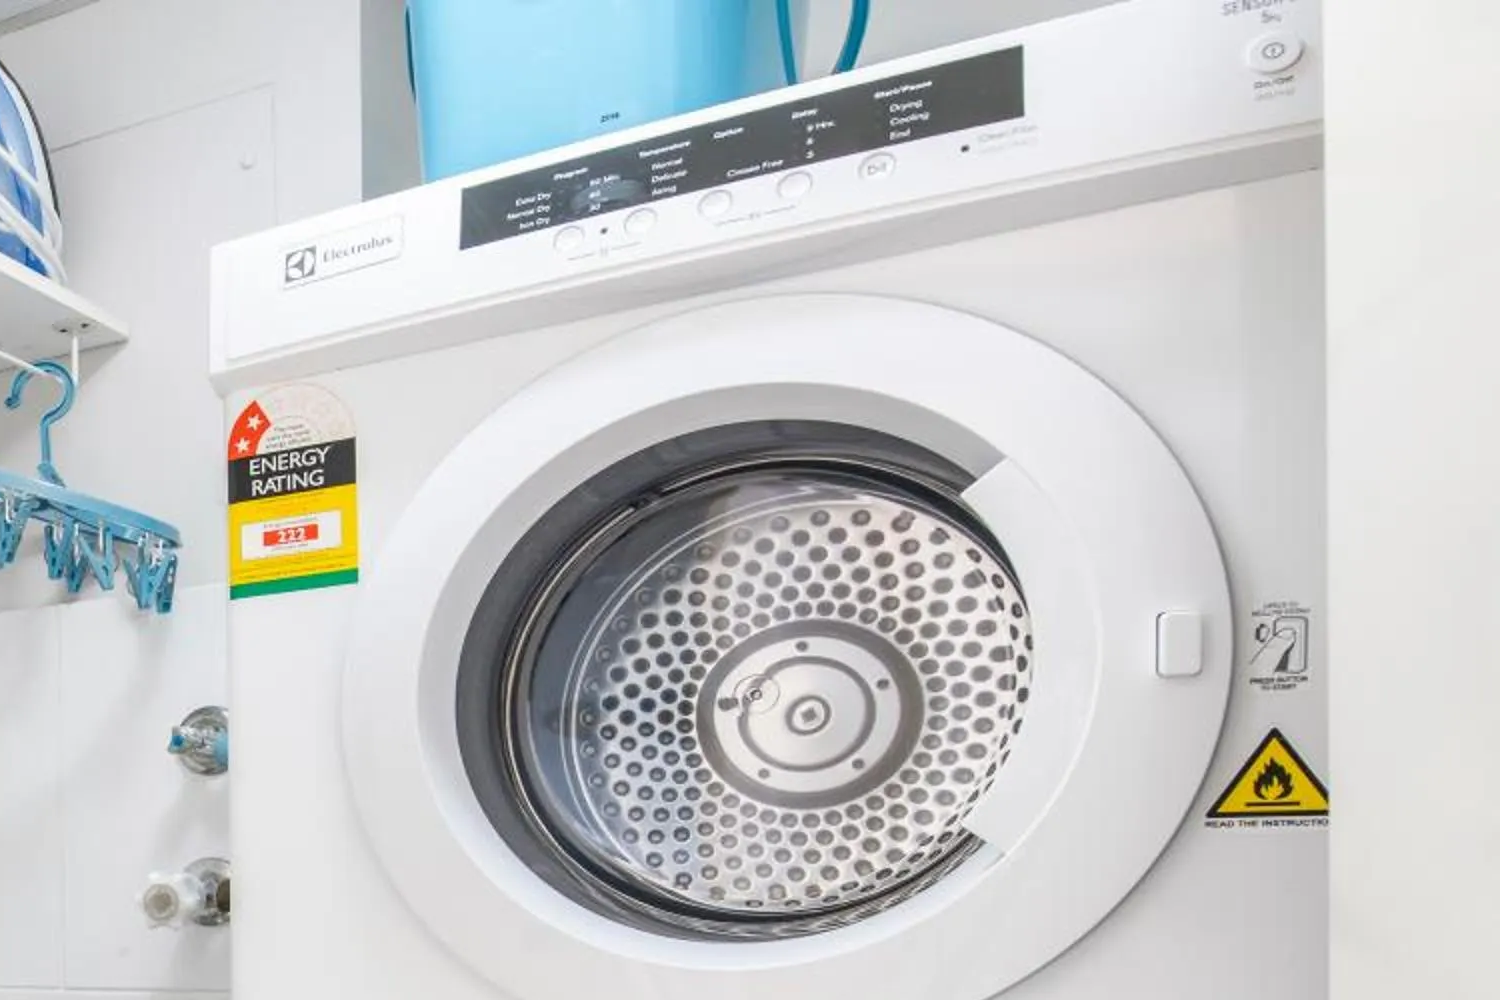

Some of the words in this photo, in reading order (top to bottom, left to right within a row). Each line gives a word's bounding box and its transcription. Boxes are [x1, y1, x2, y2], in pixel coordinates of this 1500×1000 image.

[889, 99, 923, 114] Drying
[889, 112, 931, 127] Cooling
[889, 128, 911, 141] End
[322, 235, 394, 263] Electrolux
[249, 446, 331, 476] ENERGY
[251, 469, 325, 497] RATING
[1238, 819, 1259, 828] THE
